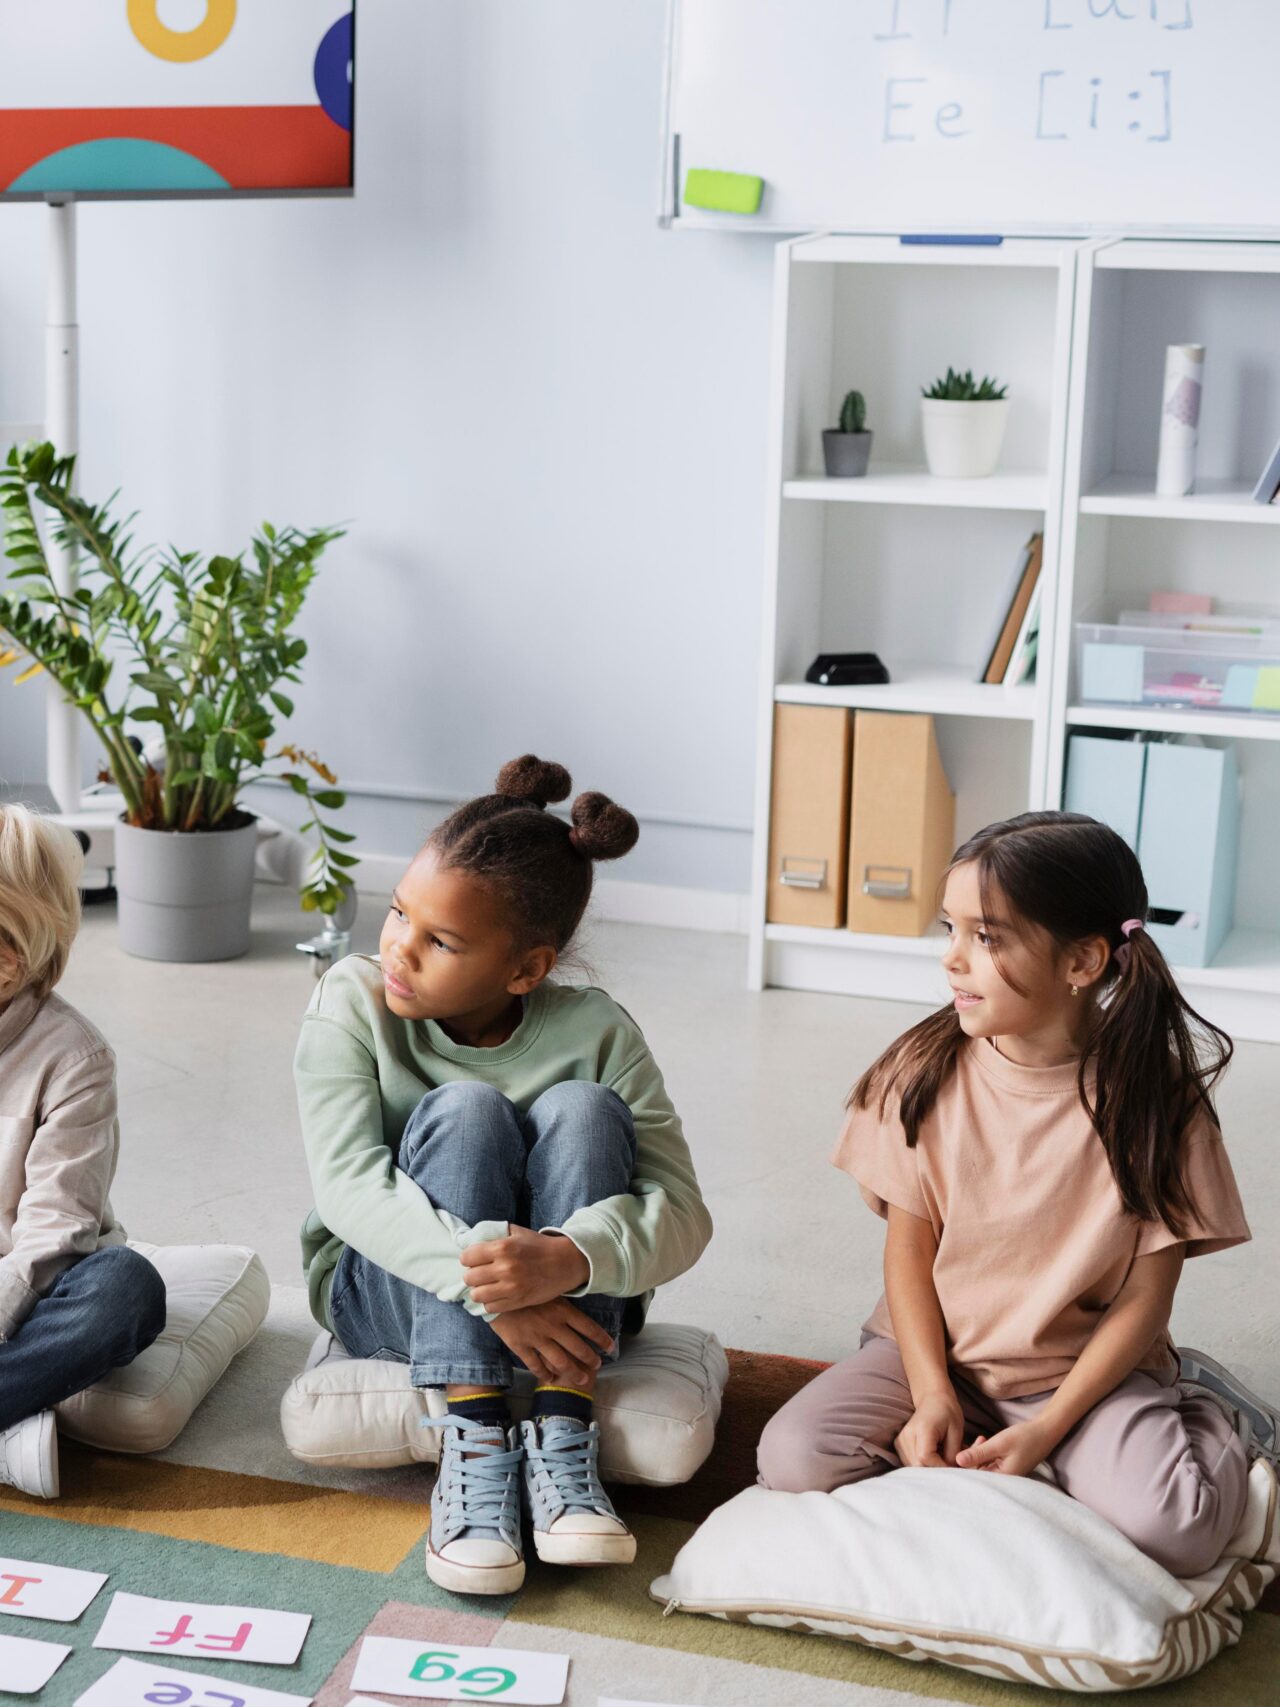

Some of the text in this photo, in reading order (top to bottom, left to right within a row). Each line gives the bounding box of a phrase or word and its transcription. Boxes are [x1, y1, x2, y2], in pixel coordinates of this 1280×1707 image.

[882, 77, 972, 142] Ee
[149, 1615, 253, 1652] Ff
[408, 1651, 518, 1696] Gg
